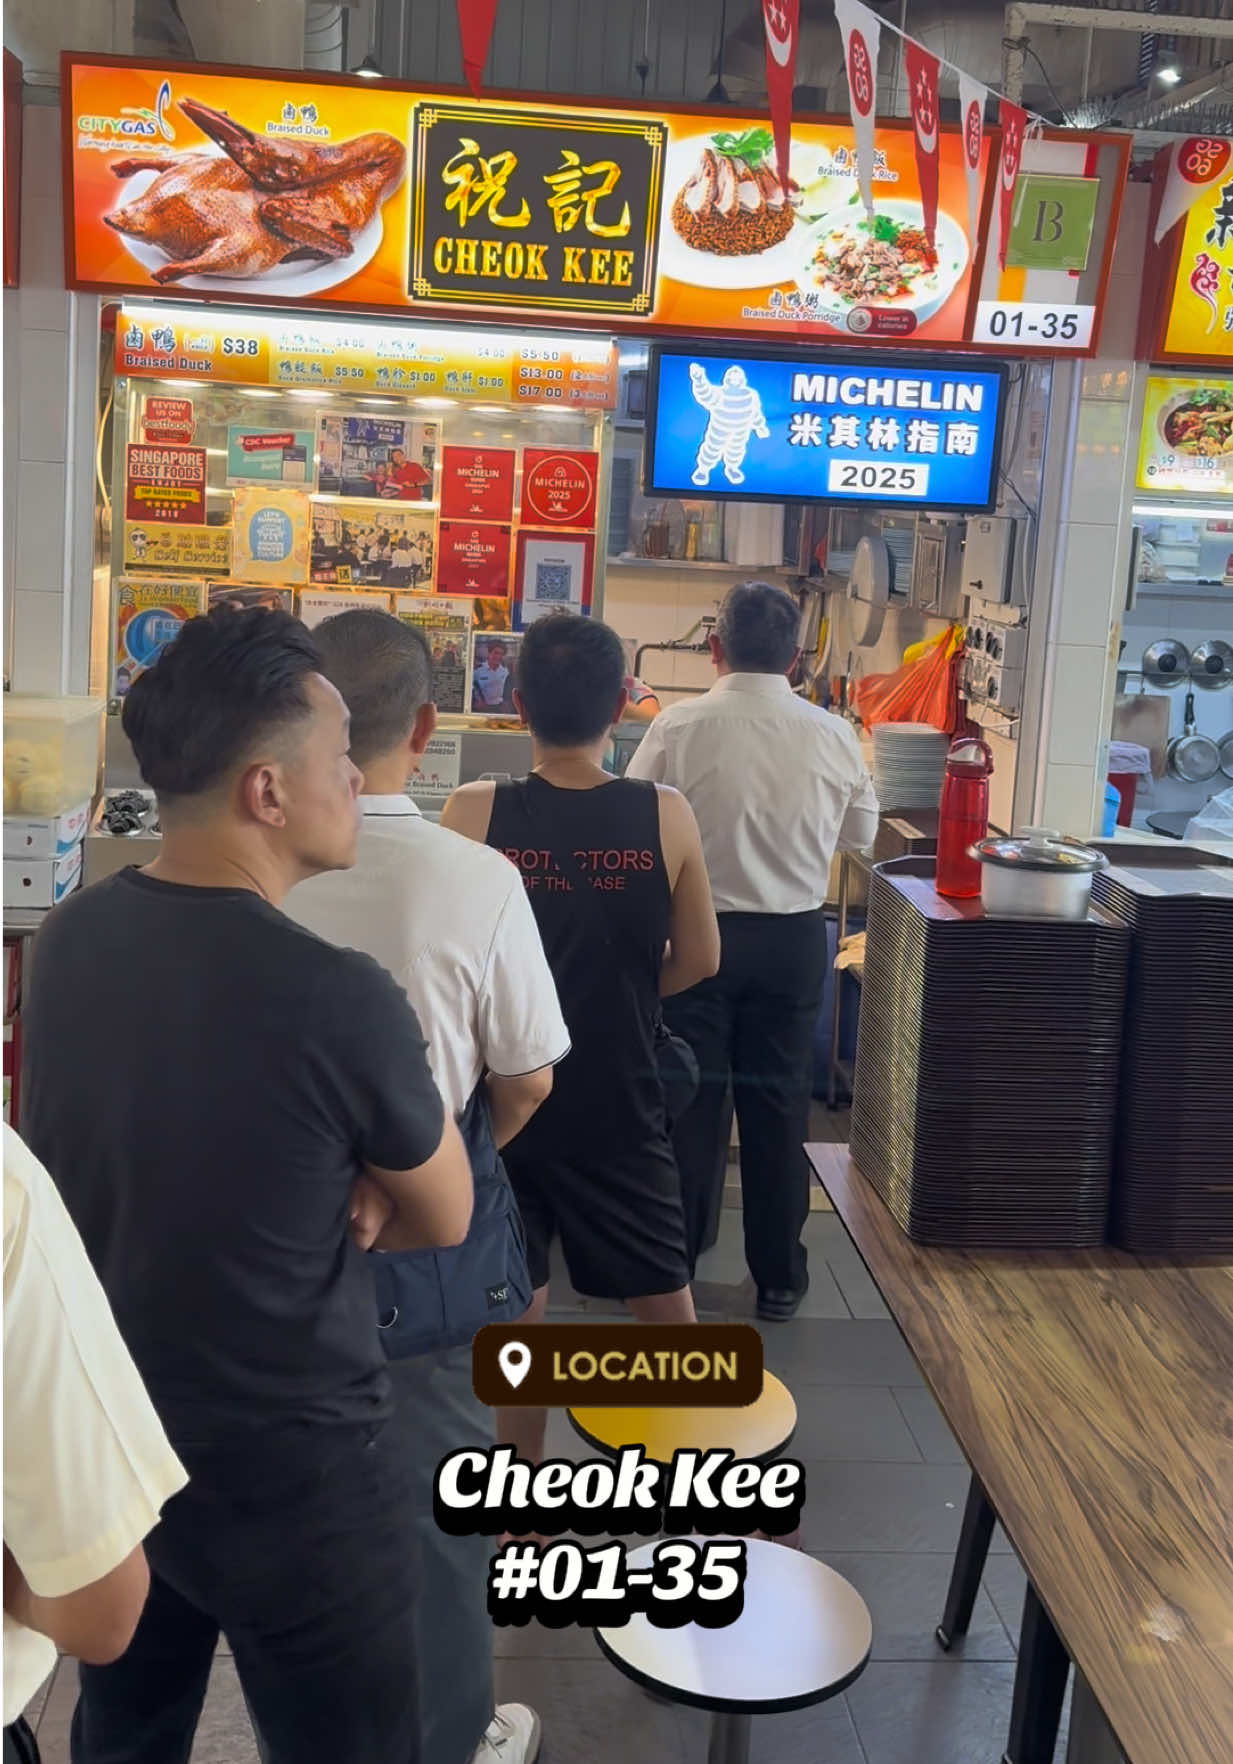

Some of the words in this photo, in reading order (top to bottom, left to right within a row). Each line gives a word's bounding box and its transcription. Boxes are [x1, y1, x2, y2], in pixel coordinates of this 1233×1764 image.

[79, 117, 156, 134] CITYGAS
[267, 122, 303, 134] Braised
[305, 125, 329, 136] Duck
[817, 166, 851, 177] Braised
[879, 170, 897, 180] Rice
[442, 138, 632, 238] 祝記
[1032, 200, 1064, 242] B
[433, 236, 549, 280] CHEOK
[561, 246, 635, 286] KEE
[743, 307, 777, 318] Braised
[778, 309, 801, 319] Duck
[802, 311, 841, 322] Porridge
[989, 310, 1078, 340] 01-35
[223, 337, 258, 356] $38
[125, 353, 174, 369] Braised
[179, 357, 212, 371] Duck
[521, 349, 559, 361] $5.50
[335, 366, 364, 378] $5.50
[792, 373, 984, 412] MICHELIN
[152, 401, 187, 410] REVIEW
[789, 413, 979, 456] 米其林指南
[130, 449, 204, 466] SINGAPORE
[132, 464, 160, 477] BEST
[163, 466, 201, 479] FOODS
[456, 467, 500, 479] MICHELIN
[841, 466, 916, 490] 2025
[534, 477, 586, 489] MICHELIN
[547, 490, 571, 500] 2025
[454, 543, 496, 553] MICHELIN
